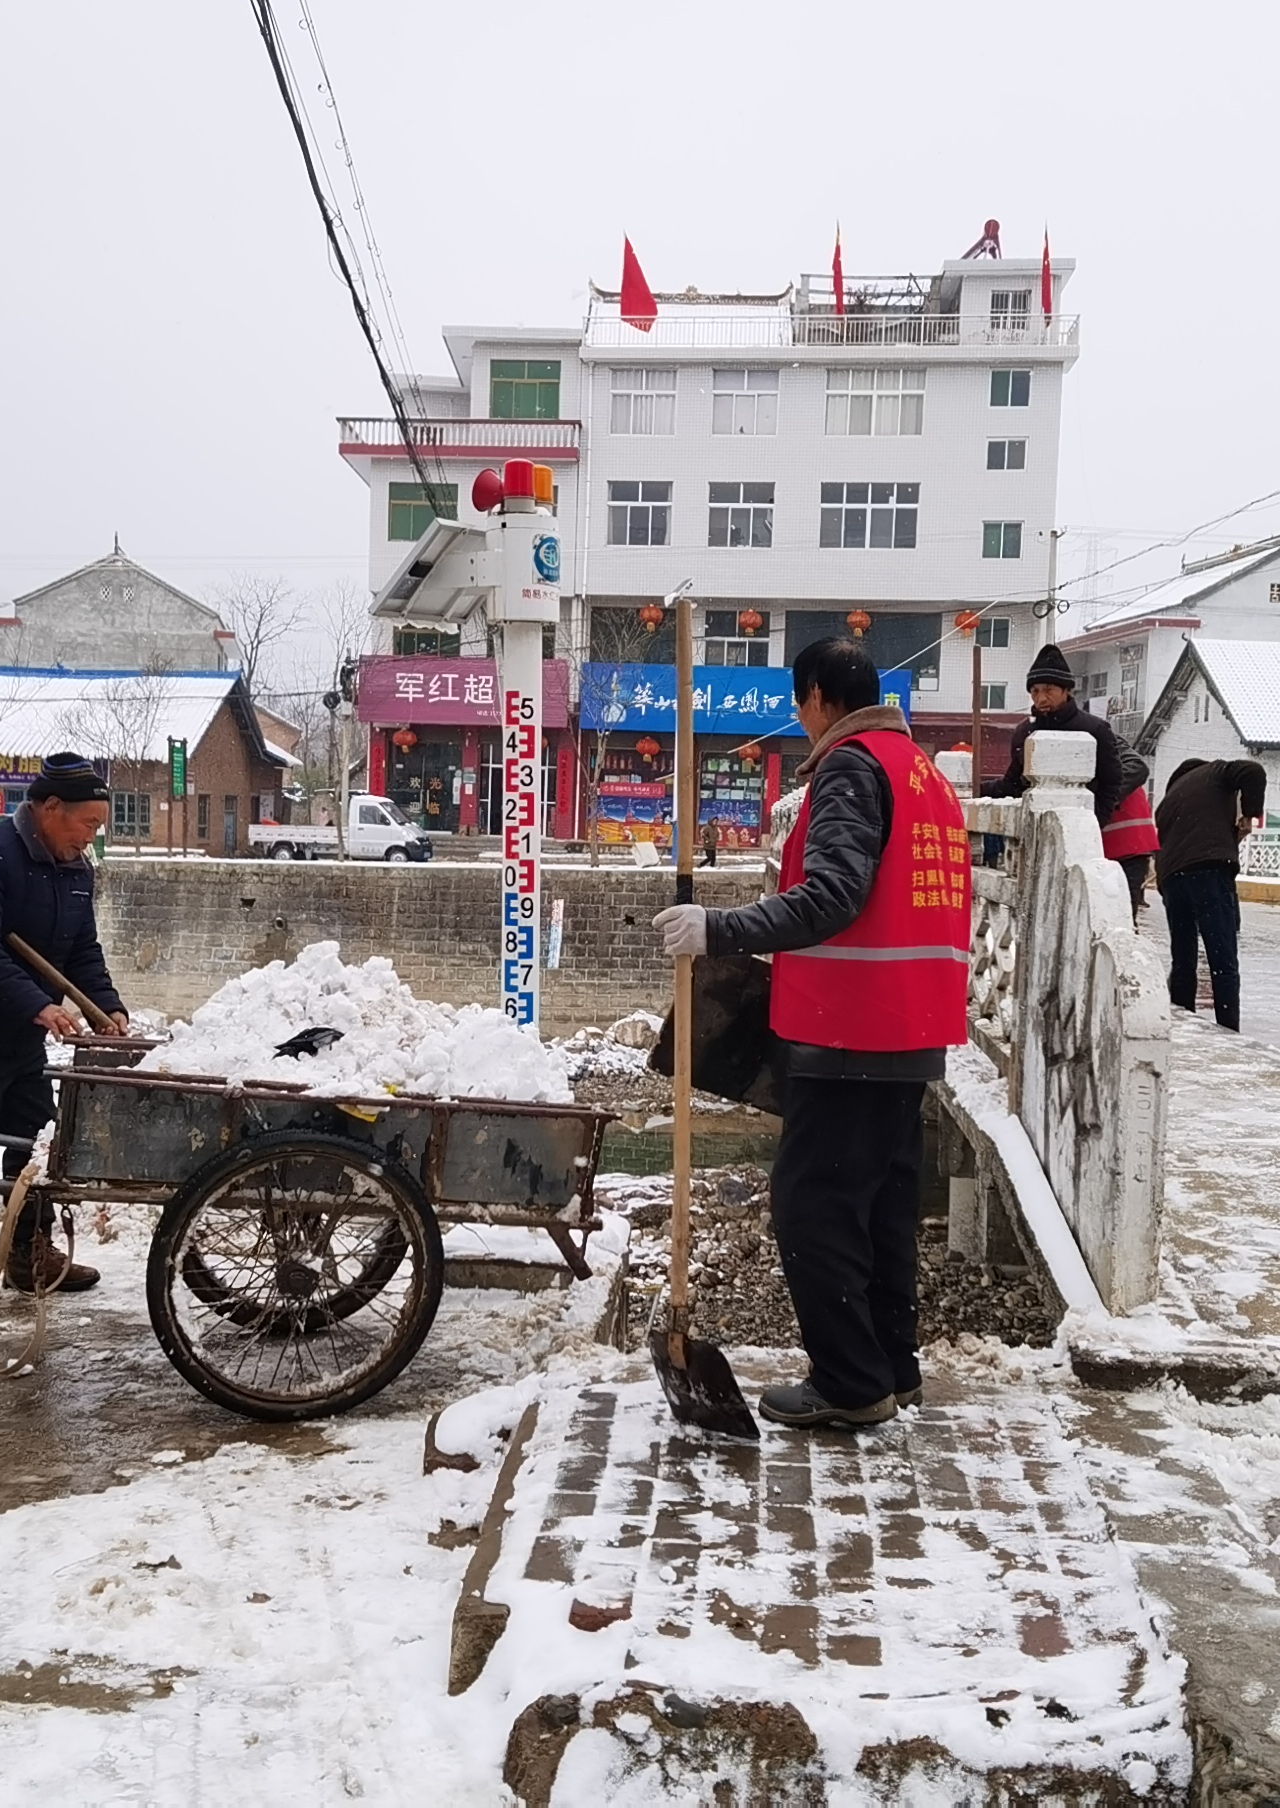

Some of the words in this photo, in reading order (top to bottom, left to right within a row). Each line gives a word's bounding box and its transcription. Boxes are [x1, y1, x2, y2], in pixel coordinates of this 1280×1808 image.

[520, 698, 534, 719] 5
[506, 731, 518, 752] 4
[520, 765, 534, 786] 3
[505, 798, 517, 820] 2
[521, 832, 531, 853] 1
[504, 865, 516, 887] 0
[520, 897, 534, 919] 9
[505, 931, 518, 953] 8
[520, 964, 534, 986] 7
[505, 998, 517, 1019] 6
